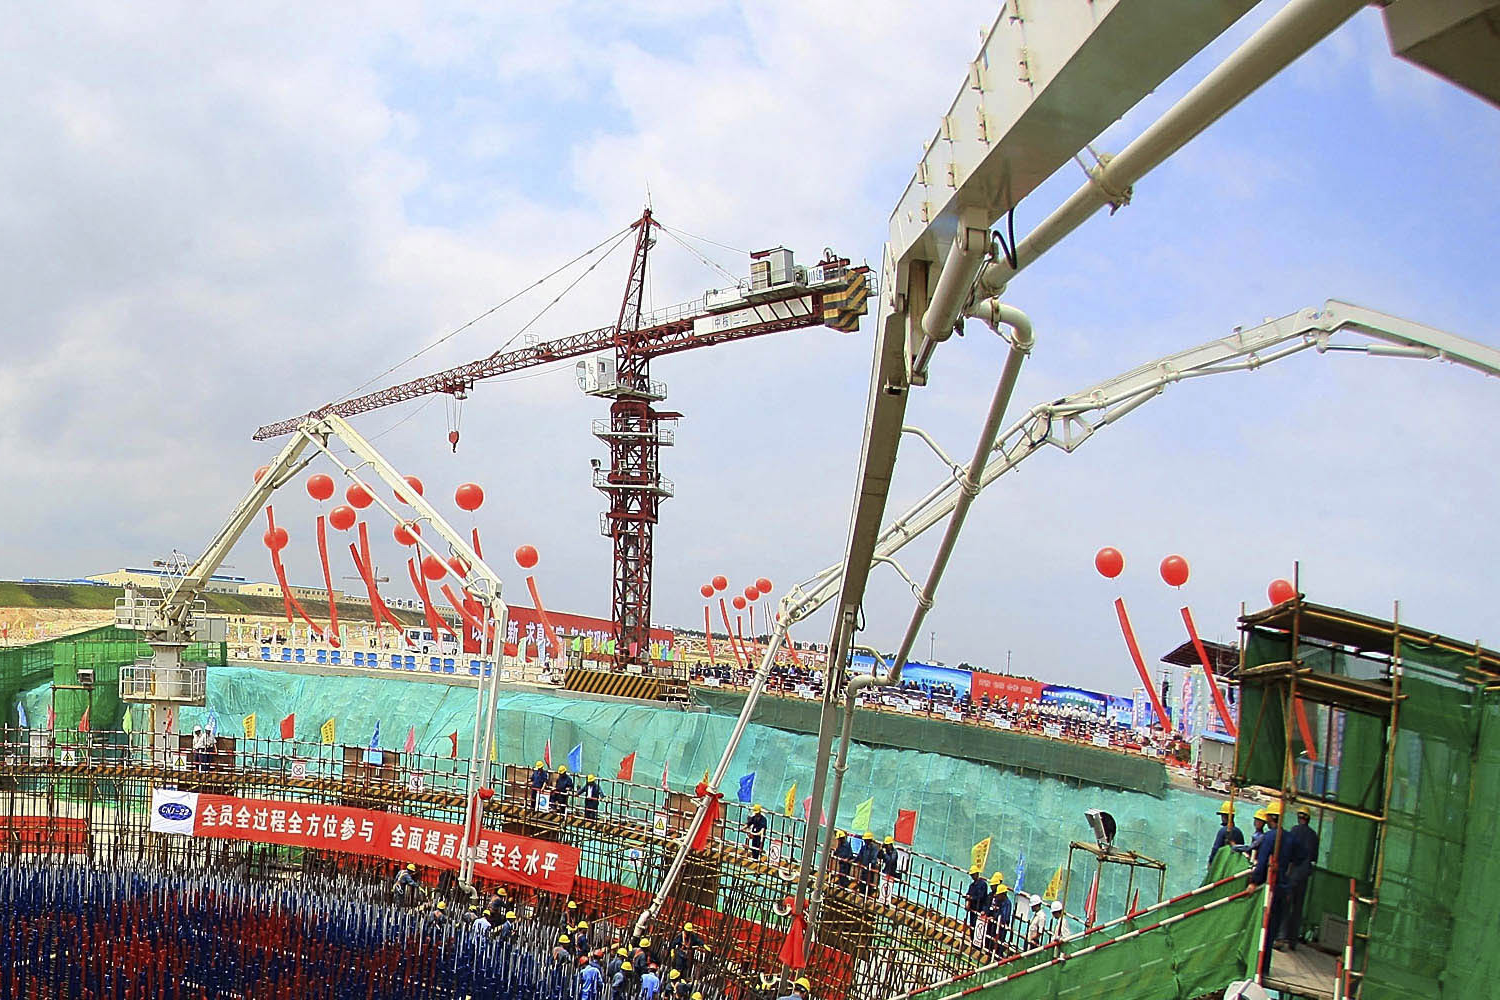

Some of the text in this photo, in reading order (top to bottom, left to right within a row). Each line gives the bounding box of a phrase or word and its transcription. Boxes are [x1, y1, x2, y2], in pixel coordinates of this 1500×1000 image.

[201, 803, 375, 844] 全员全过程全方位参与
